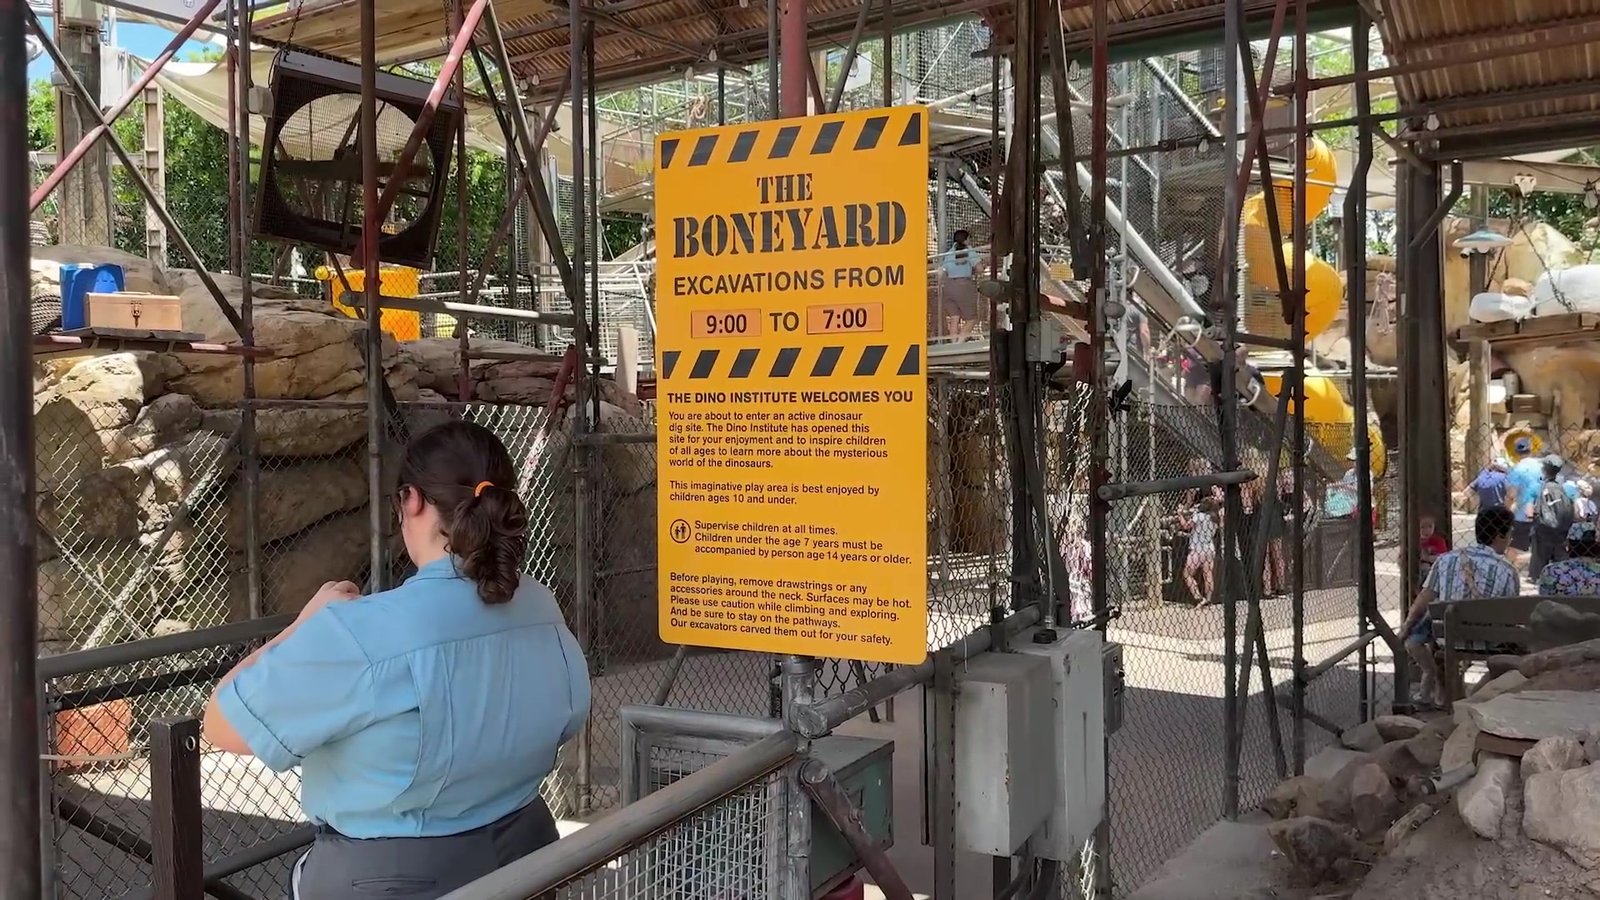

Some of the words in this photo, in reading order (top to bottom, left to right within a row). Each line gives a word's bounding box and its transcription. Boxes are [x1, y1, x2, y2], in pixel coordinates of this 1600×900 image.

[756, 172, 813, 204] THE
[672, 200, 906, 258] BONEYARD
[674, 268, 825, 296] EXCAVATIONS
[834, 264, 904, 288] FROM
[706, 313, 747, 334] 9:00
[768, 311, 800, 332] TO
[822, 307, 867, 329] 7:00
[667, 392, 691, 403] THE
[694, 391, 726, 403] DINO
[730, 391, 797, 403] INSTITUTE
[800, 390, 880, 403] WELCOMES
[883, 390, 913, 402] YOU
[668, 411, 685, 420] You
[687, 412, 702, 420] are
[704, 411, 731, 420] about
[733, 411, 743, 420] to
[745, 411, 770, 421] enter
[772, 412, 785, 420] an
[787, 410, 816, 421] active
[818, 410, 863, 421] dinosaur
[668, 422, 683, 434] dig
[685, 422, 704, 432] site.
[705, 422, 723, 432] The
[725, 422, 747, 432] Dino
[749, 422, 788, 433] Institute
[790, 422, 808, 433] has
[810, 423, 848, 434] opened
[851, 422, 870, 433] this
[668, 434, 685, 443] site
[687, 433, 700, 444] for
[702, 436, 723, 446] your
[724, 434, 773, 446] enjoyment
[775, 434, 793, 444] and
[796, 435, 806, 445] to
[809, 436, 843, 446] inspire
[845, 435, 886, 445] children
[669, 445, 678, 455] of
[680, 445, 691, 455] all
[693, 447, 715, 458] ages
[718, 446, 727, 456] to
[729, 446, 753, 456] learn
[756, 448, 781, 456] more
[783, 446, 812, 457] about
[814, 447, 830, 457] the
[833, 448, 888, 459] mysterious
[668, 457, 694, 467] world
[696, 457, 706, 467] of
[707, 457, 722, 467] the
[724, 457, 773, 468] dinosaurs.
[669, 480, 688, 490] This
[690, 482, 743, 492] imaginative
[744, 482, 764, 493] play
[766, 484, 788, 492] area
[790, 485, 799, 493] is
[801, 483, 823, 494] best
[825, 484, 864, 496] enjoyed
[867, 485, 879, 497] by
[669, 491, 705, 502] children
[707, 494, 730, 504] ages
[733, 493, 744, 503] 10
[746, 494, 764, 504] and
[767, 494, 797, 505] under.
[694, 519, 740, 531] Supervise
[741, 522, 779, 532] children
[781, 524, 792, 533] at
[794, 524, 806, 534] all
[808, 524, 838, 535] times.
[694, 531, 733, 543] Children
[735, 534, 763, 544] under
[764, 535, 780, 545] the
[782, 538, 801, 548] age
[803, 537, 810, 546] 7
[812, 539, 839, 549] years
[842, 540, 867, 550] must
[869, 540, 883, 550] be
[694, 545, 756, 556] accompanied
[758, 546, 769, 558] by
[771, 549, 804, 558] person
[806, 551, 825, 561] age
[826, 550, 838, 560] 14
[840, 553, 868, 563] years
[869, 554, 881, 563] or
[882, 553, 912, 564] older.
[669, 571, 699, 583] Before
[701, 573, 737, 587] playing,
[739, 578, 774, 587] remove
[776, 578, 833, 592] drawstrings
[849, 584, 867, 595] any
[669, 585, 723, 596] accessories
[725, 588, 758, 598] around
[760, 589, 776, 599] the
[778, 591, 803, 601] neck.
[806, 591, 850, 604] Surfaces
[852, 597, 874, 608] may
[876, 596, 890, 607] be
[892, 597, 912, 608] hot.
[670, 594, 700, 606] Please
[702, 598, 719, 607] use
[720, 599, 755, 609] caution
[757, 601, 782, 612] while
[784, 602, 825, 617] climbing
[828, 606, 847, 616] and
[850, 608, 899, 622] exploring.
[670, 605, 688, 616] And
[690, 607, 702, 617] be
[703, 610, 724, 619] sure
[726, 610, 736, 620] to
[738, 611, 758, 623] stay
[759, 614, 772, 622] on
[774, 614, 790, 624] the
[792, 616, 840, 629] pathways.
[670, 617, 688, 628] Our
[689, 620, 737, 632] excavators
[739, 624, 771, 635] carved
[773, 625, 798, 637] them
[800, 629, 816, 638] out
[819, 629, 833, 639] for
[835, 633, 858, 642] your
[860, 633, 892, 646] safety.
